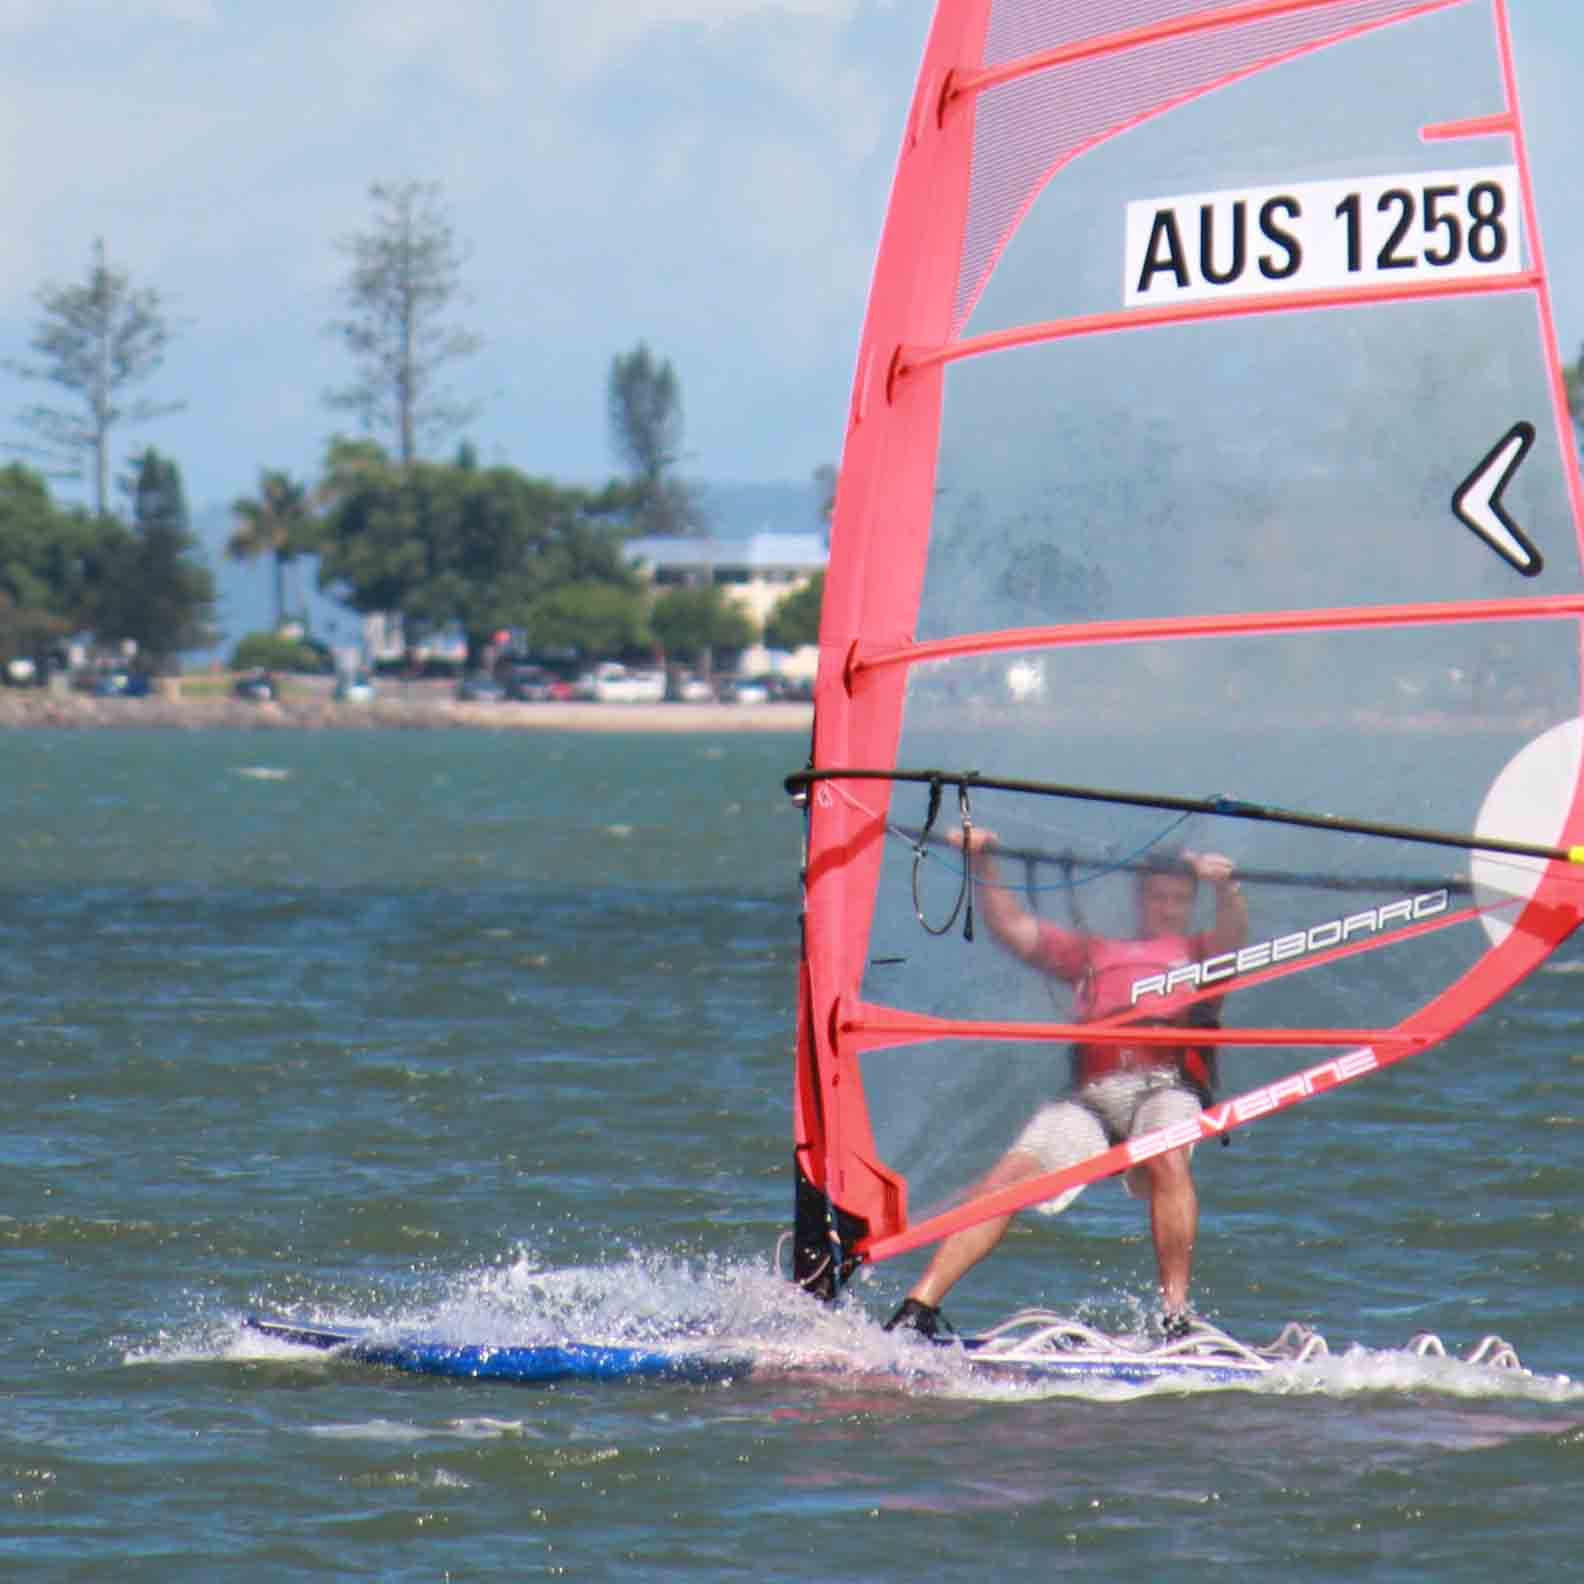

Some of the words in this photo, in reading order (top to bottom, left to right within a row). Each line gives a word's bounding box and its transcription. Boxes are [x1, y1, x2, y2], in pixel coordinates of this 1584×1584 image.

[1137, 194, 1304, 293] AUS
[1334, 181, 1508, 273] 1258
[1130, 888, 1449, 1005] RACEBOARD
